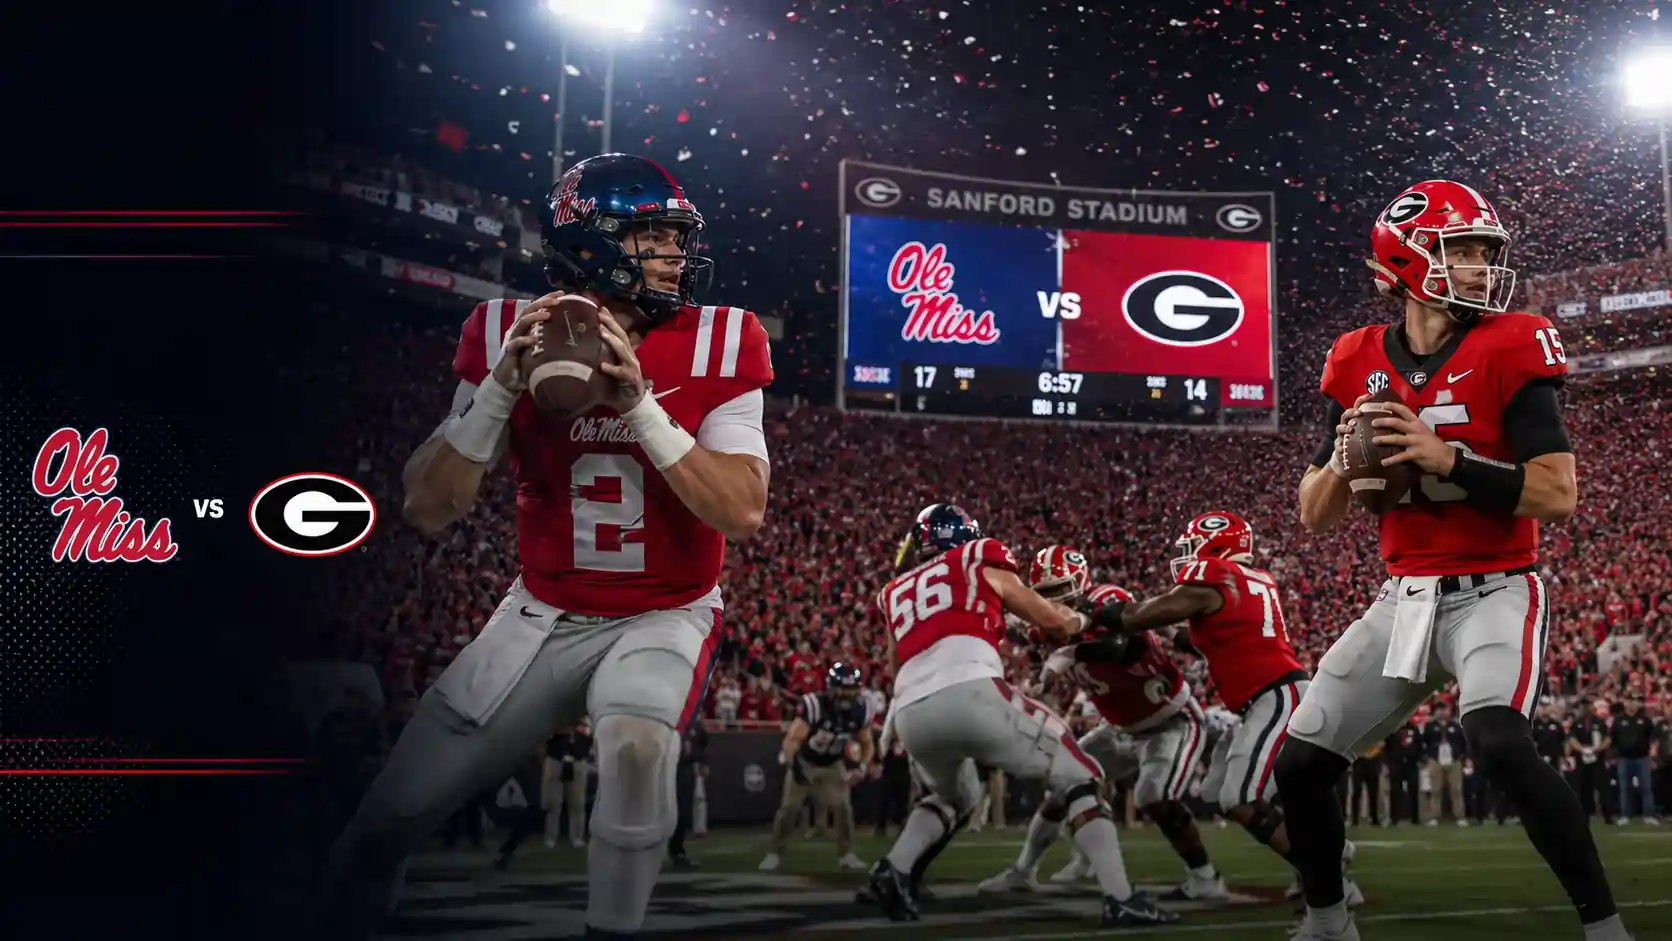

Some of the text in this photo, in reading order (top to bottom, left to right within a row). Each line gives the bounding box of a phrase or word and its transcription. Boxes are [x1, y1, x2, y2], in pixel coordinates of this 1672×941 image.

[927, 187, 1187, 226] SANFORD STADIUM
[887, 241, 954, 295] Ole
[901, 290, 1000, 345] Miss
[1037, 291, 1082, 320] VS
[1535, 327, 1567, 366] 15
[914, 366, 937, 389] 17
[1038, 372, 1084, 394] 6:57
[1184, 378, 1208, 401] 14
[570, 417, 598, 442] Ole
[570, 453, 645, 572] 2
[1183, 560, 1208, 581] 71
[889, 562, 953, 642] 56
[1246, 579, 1290, 643] 71
